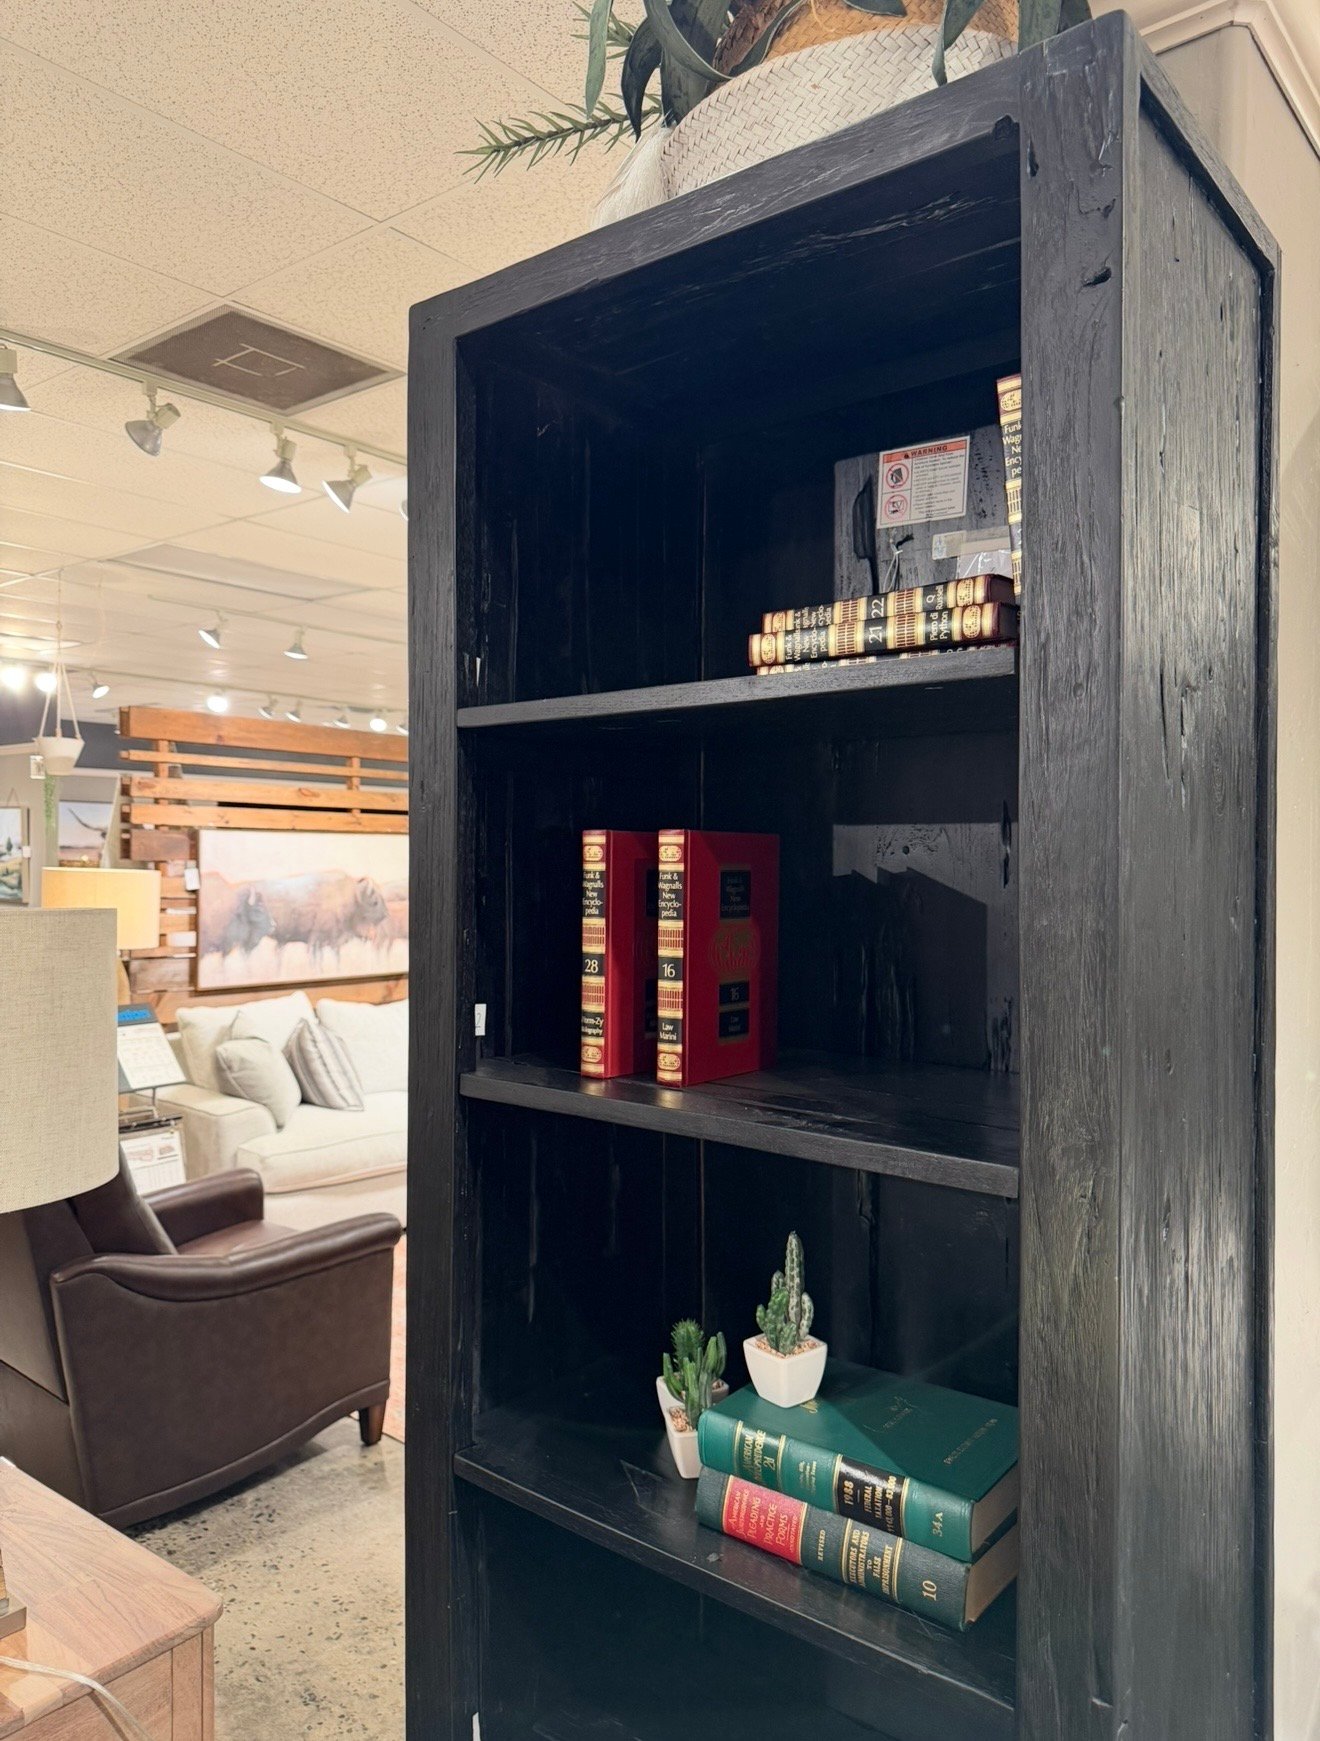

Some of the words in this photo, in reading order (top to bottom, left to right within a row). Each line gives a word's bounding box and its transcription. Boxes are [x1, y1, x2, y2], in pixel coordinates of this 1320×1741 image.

[911, 445, 947, 456] WARNING
[870, 597, 884, 619] 22
[926, 594, 936, 604] Q
[930, 612, 939, 620] di
[939, 611, 950, 640] Python
[868, 626, 883, 643] 21
[930, 620, 939, 641] Piero
[810, 627, 818, 659] Encyclo-
[820, 631, 828, 652] pedia
[659, 872, 672, 880] Funk
[673, 872, 679, 880] &
[586, 890, 598, 898] New
[662, 891, 676, 900] New
[585, 907, 599, 916] pedia
[661, 908, 678, 919] pedia
[584, 959, 599, 974] 28
[662, 963, 676, 978] 16
[660, 1032, 677, 1041] Marini
[662, 1022, 674, 1031] Law
[763, 1456, 776, 1471] 2d
[844, 1480, 854, 1506] 1988
[864, 1485, 872, 1513] FEDERAL
[874, 1485, 883, 1519] TAXATION
[728, 1491, 741, 1529] AMERICAN
[747, 1496, 761, 1538] PLEADING
[763, 1503, 778, 1546] PRACTICE
[775, 1514, 788, 1546] FORMS
[817, 1529, 826, 1561] REVISED
[851, 1529, 861, 1546] AND
[849, 1547, 858, 1584] EXECUTORS
[867, 1559, 873, 1570] TO
[872, 1556, 882, 1578] FALSE
[881, 1544, 893, 1596] IMPRISONMENT
[922, 1580, 937, 1601] 10
